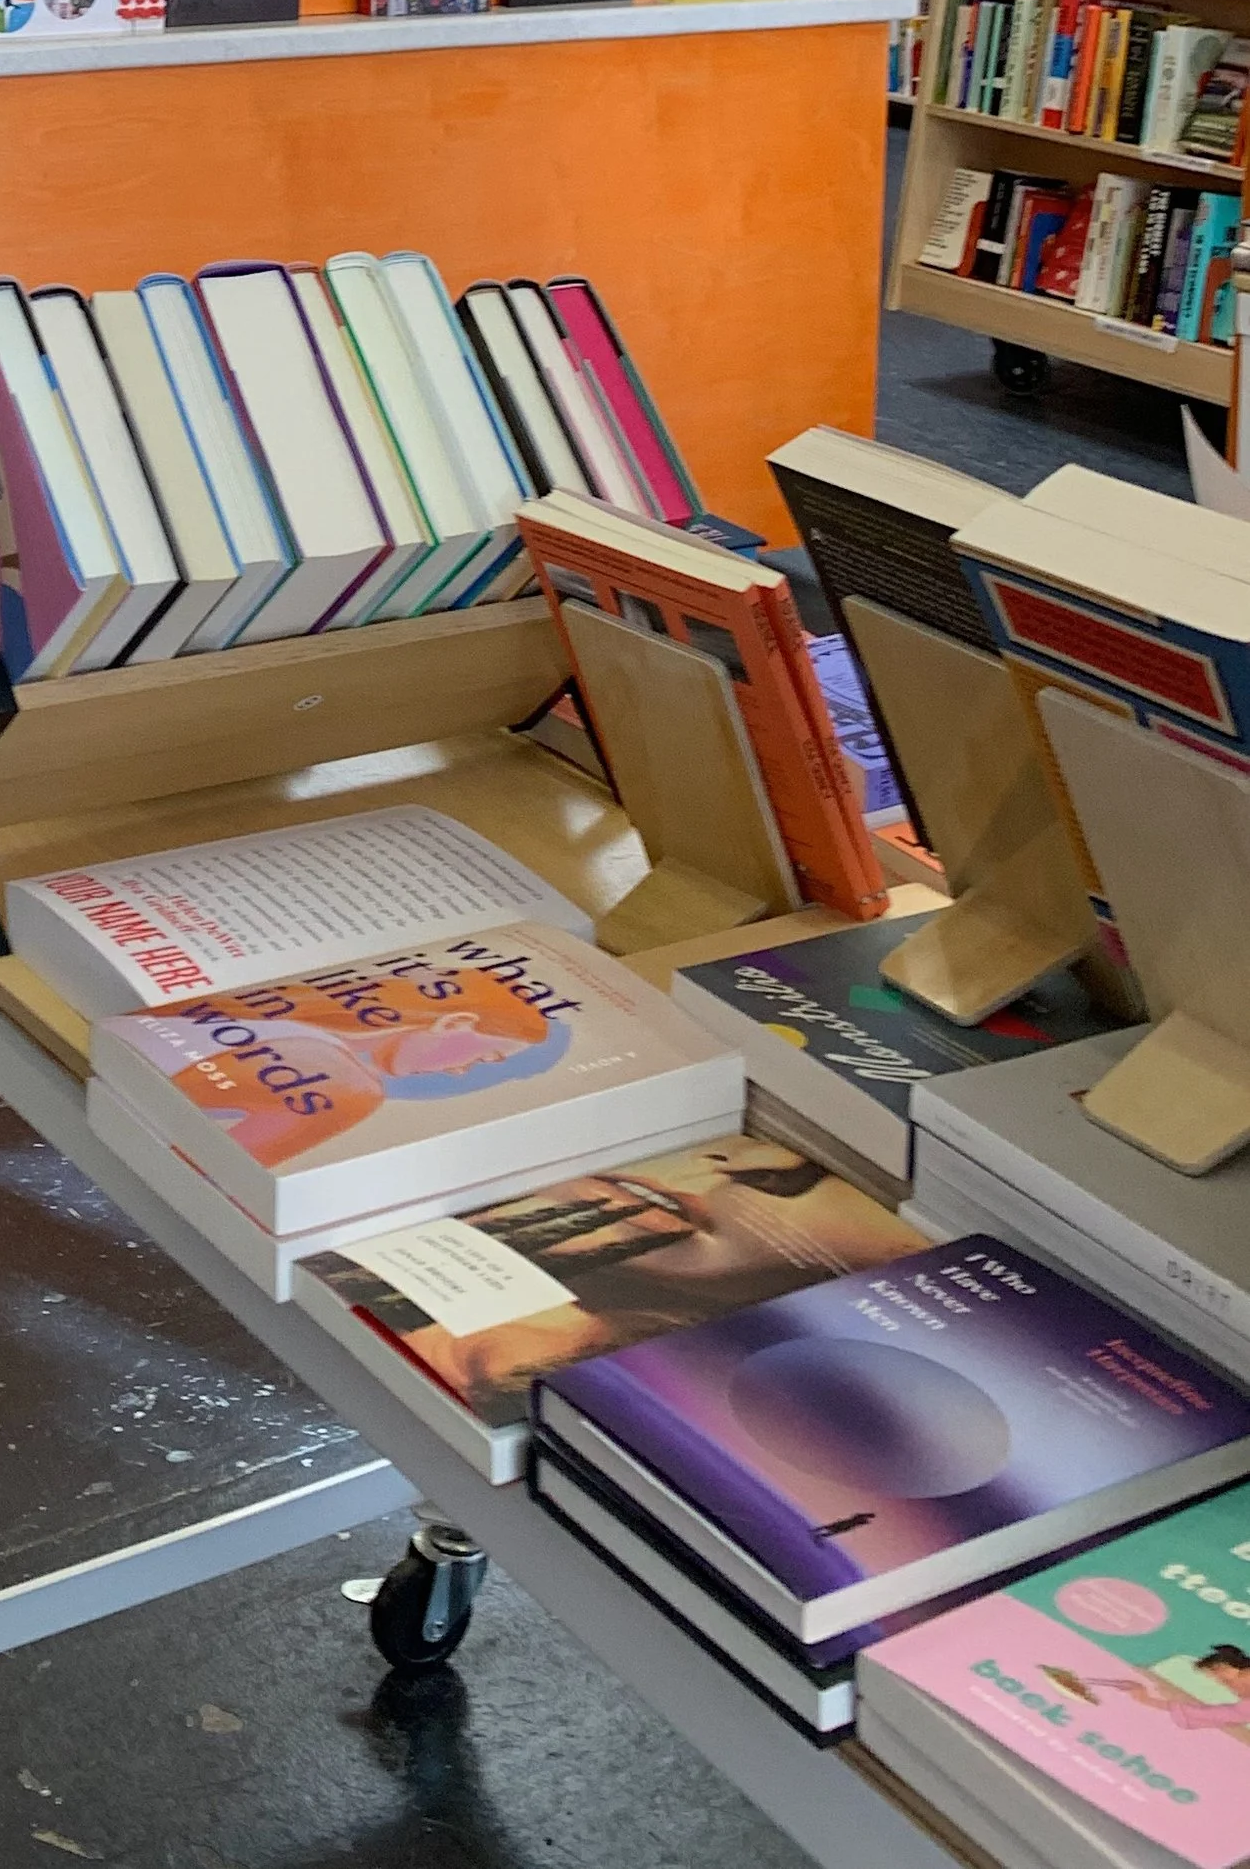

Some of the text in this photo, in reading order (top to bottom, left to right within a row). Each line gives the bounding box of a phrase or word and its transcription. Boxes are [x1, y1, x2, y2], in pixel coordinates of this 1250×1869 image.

[45, 872, 215, 995] YOUR NAME HERE
[166, 895, 203, 929] Helen
[302, 968, 402, 1027] like
[370, 953, 465, 1002] it's
[445, 939, 585, 1020] what
[235, 985, 296, 1021] in
[137, 1017, 239, 1093] ELIZA MOSS
[178, 1000, 335, 1117] words
[905, 1273, 973, 1314] Never
[939, 1266, 1001, 1302] Have
[981, 1258, 1038, 1296] Who
[851, 1297, 901, 1332] Men
[868, 1279, 948, 1331] Known
[968, 1658, 1200, 1805] baek sehee
